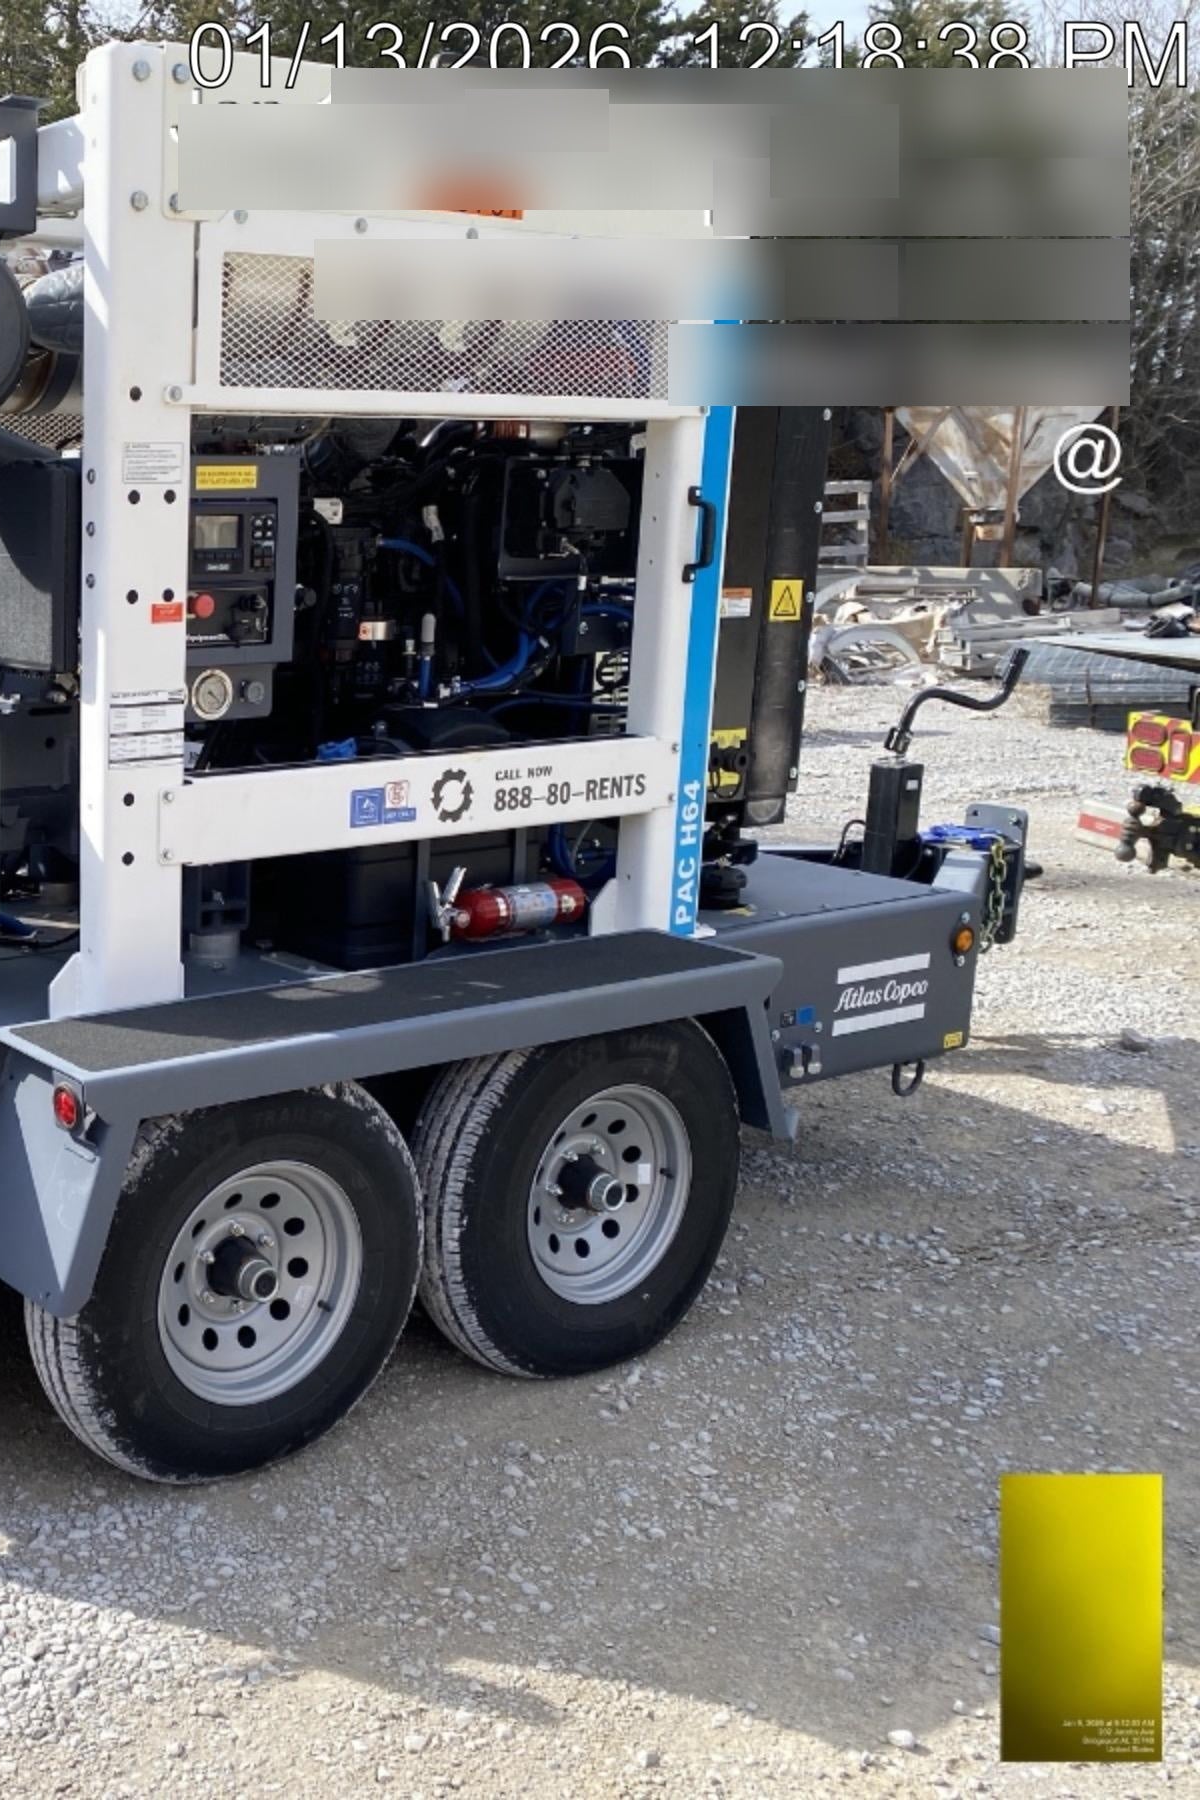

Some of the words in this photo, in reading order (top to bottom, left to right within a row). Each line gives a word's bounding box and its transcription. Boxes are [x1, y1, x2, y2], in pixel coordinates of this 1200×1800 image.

[493, 773, 647, 812] 888-80-RENTS
[495, 768, 522, 781] CALL
[527, 765, 553, 779] NOW
[680, 779, 701, 846] H64
[675, 856, 696, 925] PAC
[833, 986, 882, 1013] Atlas
[883, 979, 929, 1005] Copco
